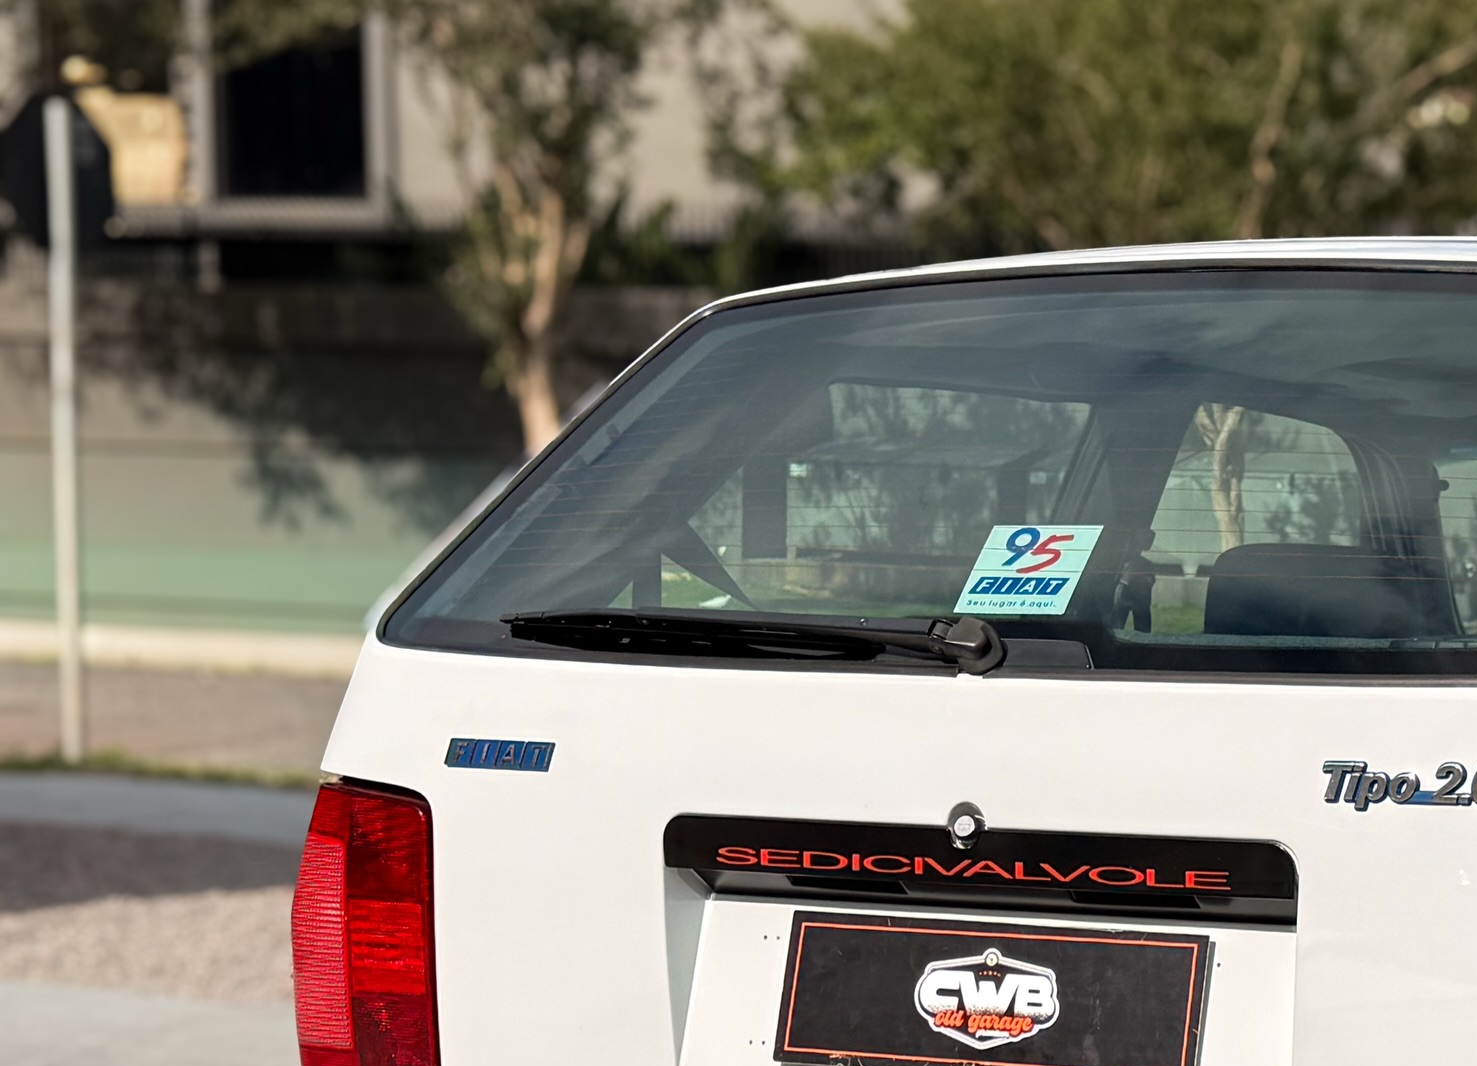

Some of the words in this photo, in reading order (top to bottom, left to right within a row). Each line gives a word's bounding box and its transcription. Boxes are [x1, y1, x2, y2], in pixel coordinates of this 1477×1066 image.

[1002, 527, 1074, 573] 95
[973, 578, 1064, 594] FIAT
[988, 600, 1018, 608] lugar
[450, 739, 549, 769] FIAT
[1322, 760, 1421, 811] Tipo
[715, 846, 1231, 891] SEDICIVALVOLE
[919, 969, 1056, 1019] CWB
[934, 1010, 965, 1028] old
[967, 1015, 1034, 1036] garage
